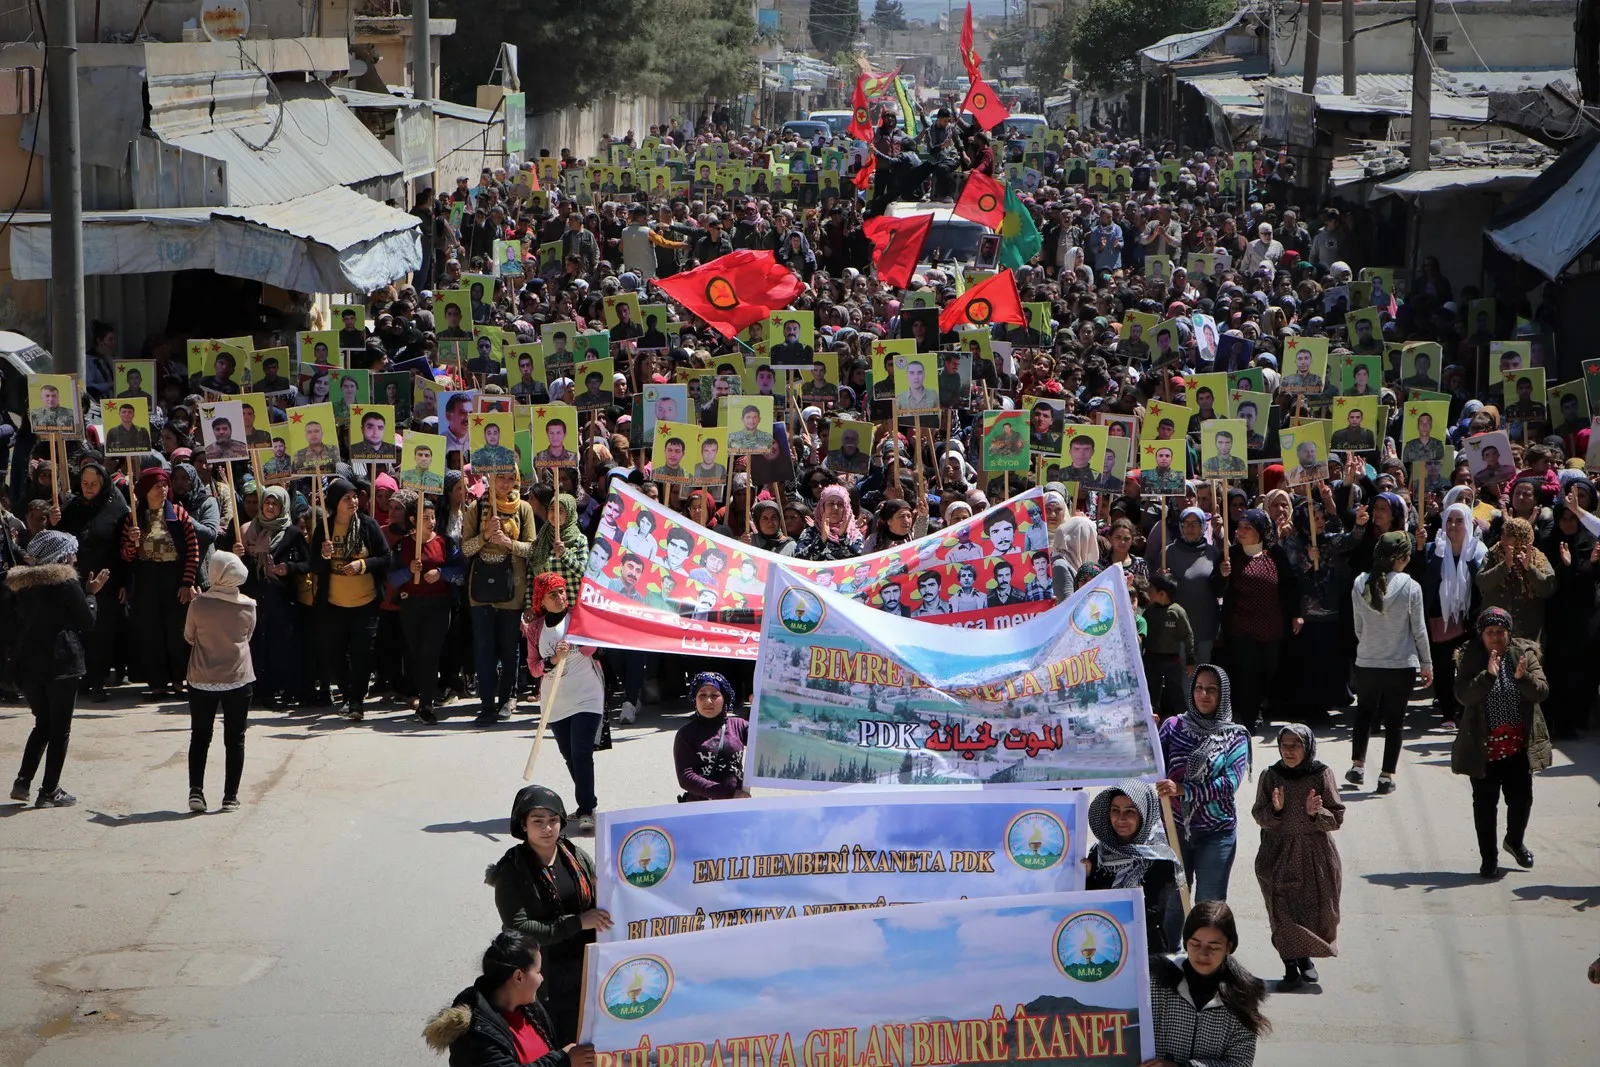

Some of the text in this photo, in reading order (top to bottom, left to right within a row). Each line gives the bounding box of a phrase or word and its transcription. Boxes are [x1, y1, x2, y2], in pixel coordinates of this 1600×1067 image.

[1049, 647, 1106, 691] PDK
[858, 720, 1063, 760] الموت لخيانة PDK
[693, 844, 995, 883] EM LI HEMBERÎ ÎXANETA PDK
[803, 1023, 905, 1067] GELAN
[911, 1004, 1009, 1067] BIMRÊ
[1014, 1003, 1129, 1060] ÎXANET
